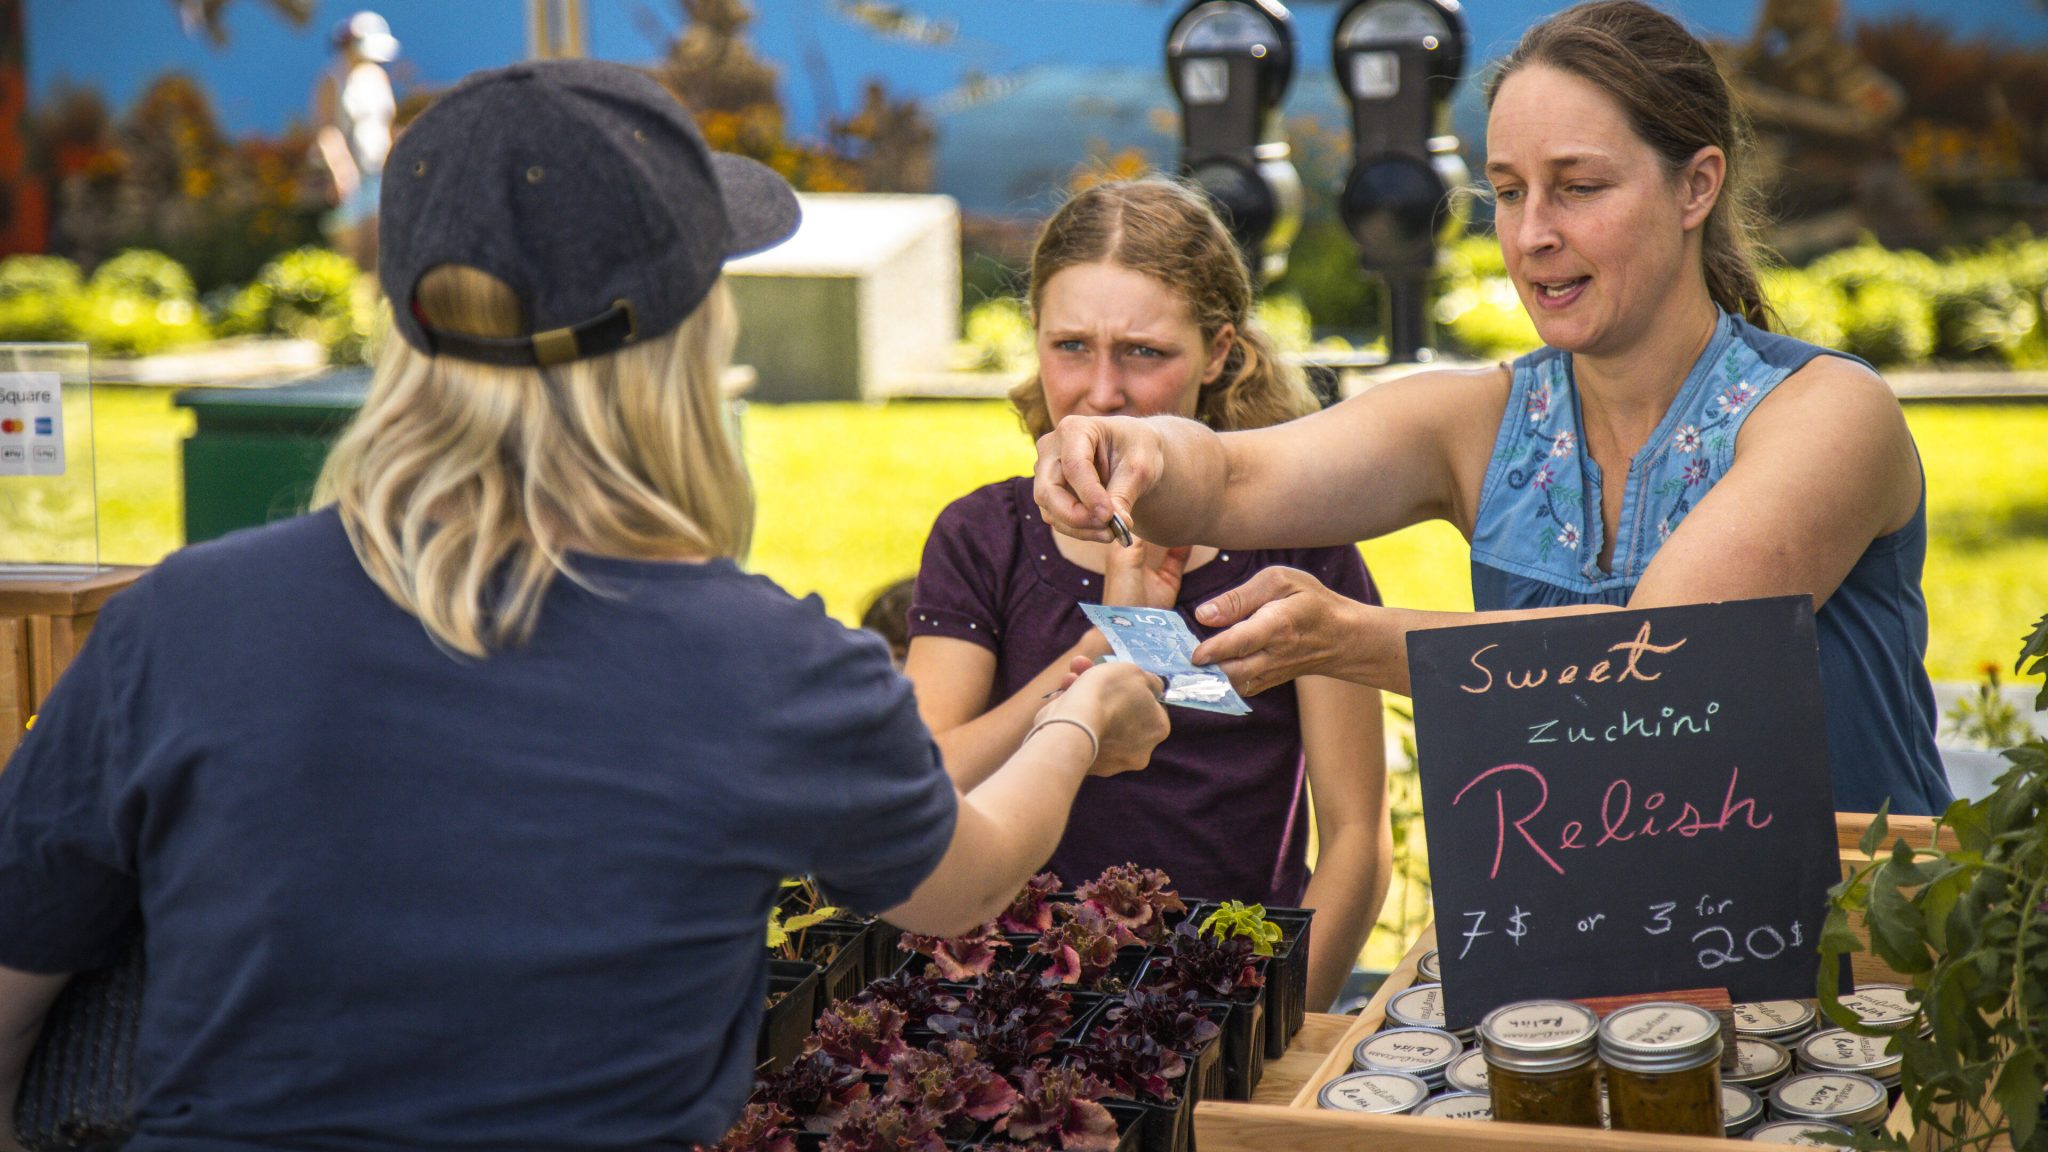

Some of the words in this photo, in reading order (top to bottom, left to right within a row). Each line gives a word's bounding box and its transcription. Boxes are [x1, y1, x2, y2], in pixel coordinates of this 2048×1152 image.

[1135, 613, 1167, 626] 5
[1461, 621, 1687, 693] Sweet
[1453, 763, 1773, 879] Relish
[1577, 913, 1605, 932] or
[1644, 901, 1676, 935] 3
[1695, 894, 1733, 916] for
